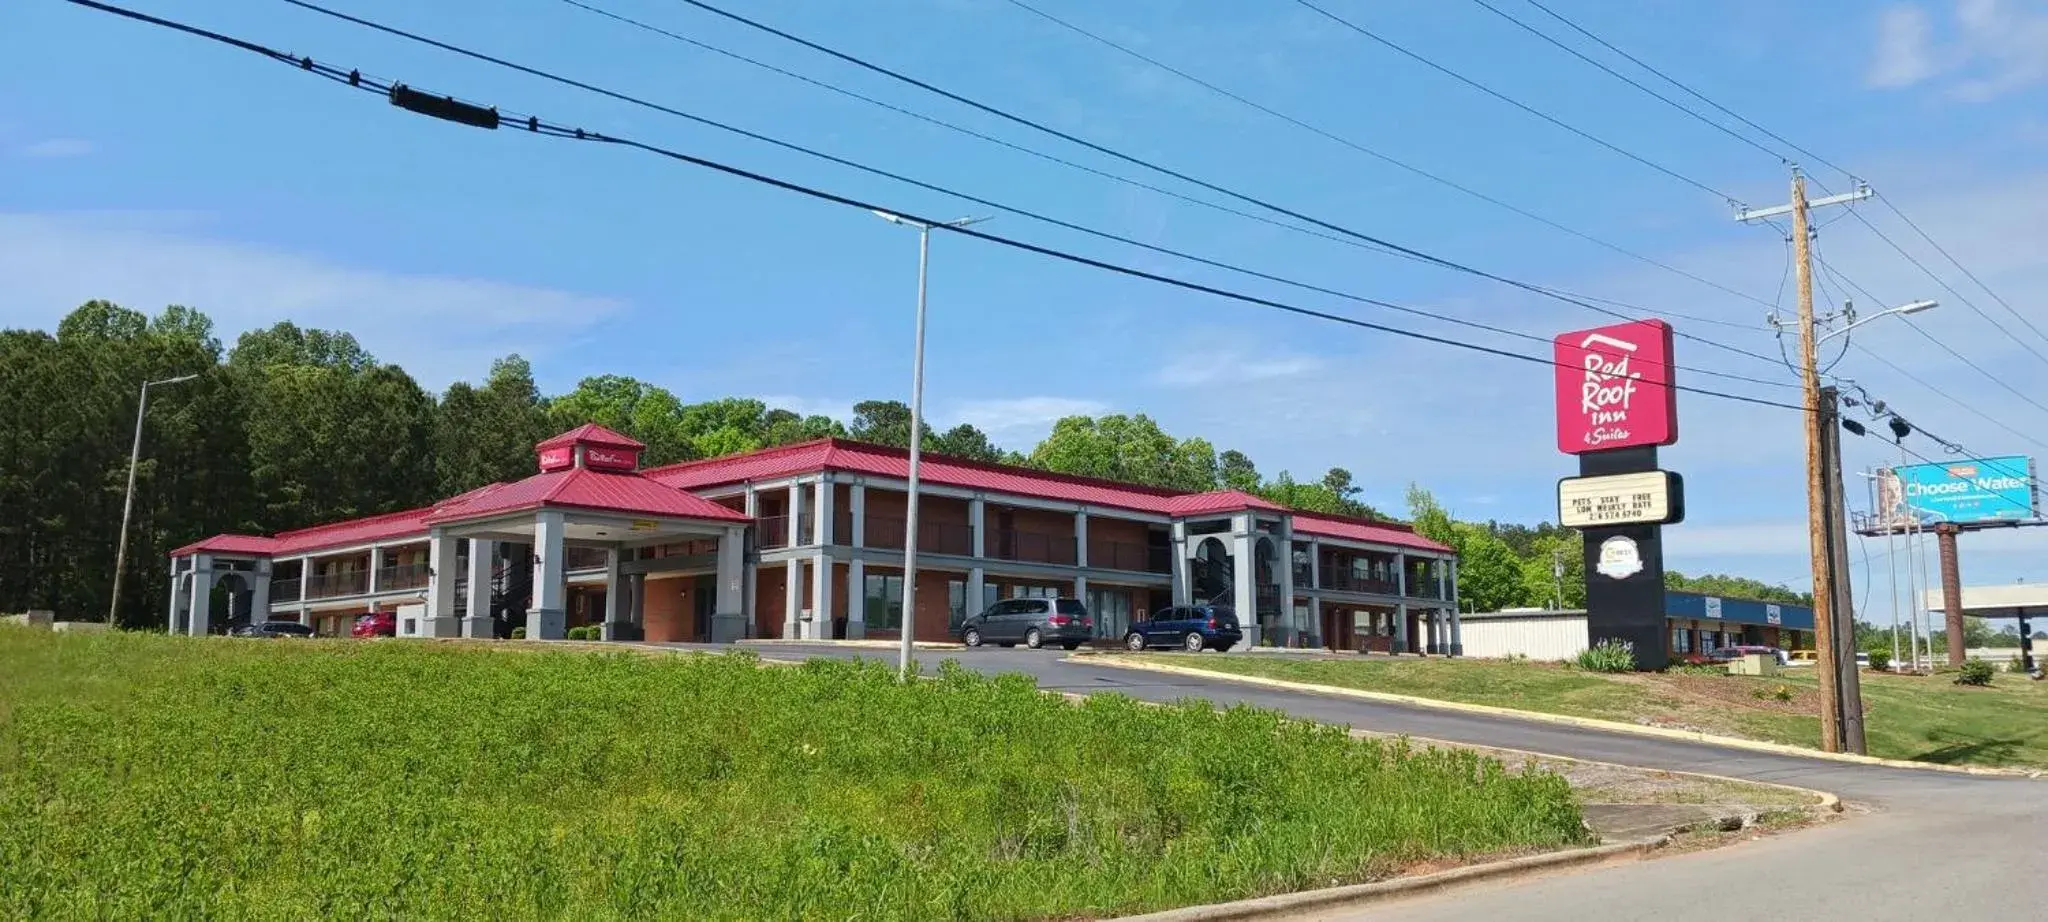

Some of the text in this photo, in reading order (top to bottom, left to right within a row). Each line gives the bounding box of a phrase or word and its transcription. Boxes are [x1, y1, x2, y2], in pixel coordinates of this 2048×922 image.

[1585, 354, 1629, 383] Red
[1582, 372, 1641, 414] Roof
[1591, 427, 1631, 445] Suites
[1906, 476, 2029, 497] Choose Water
[1572, 492, 1652, 506] PETS STAY FREE
[1576, 505, 1592, 514] LOW
